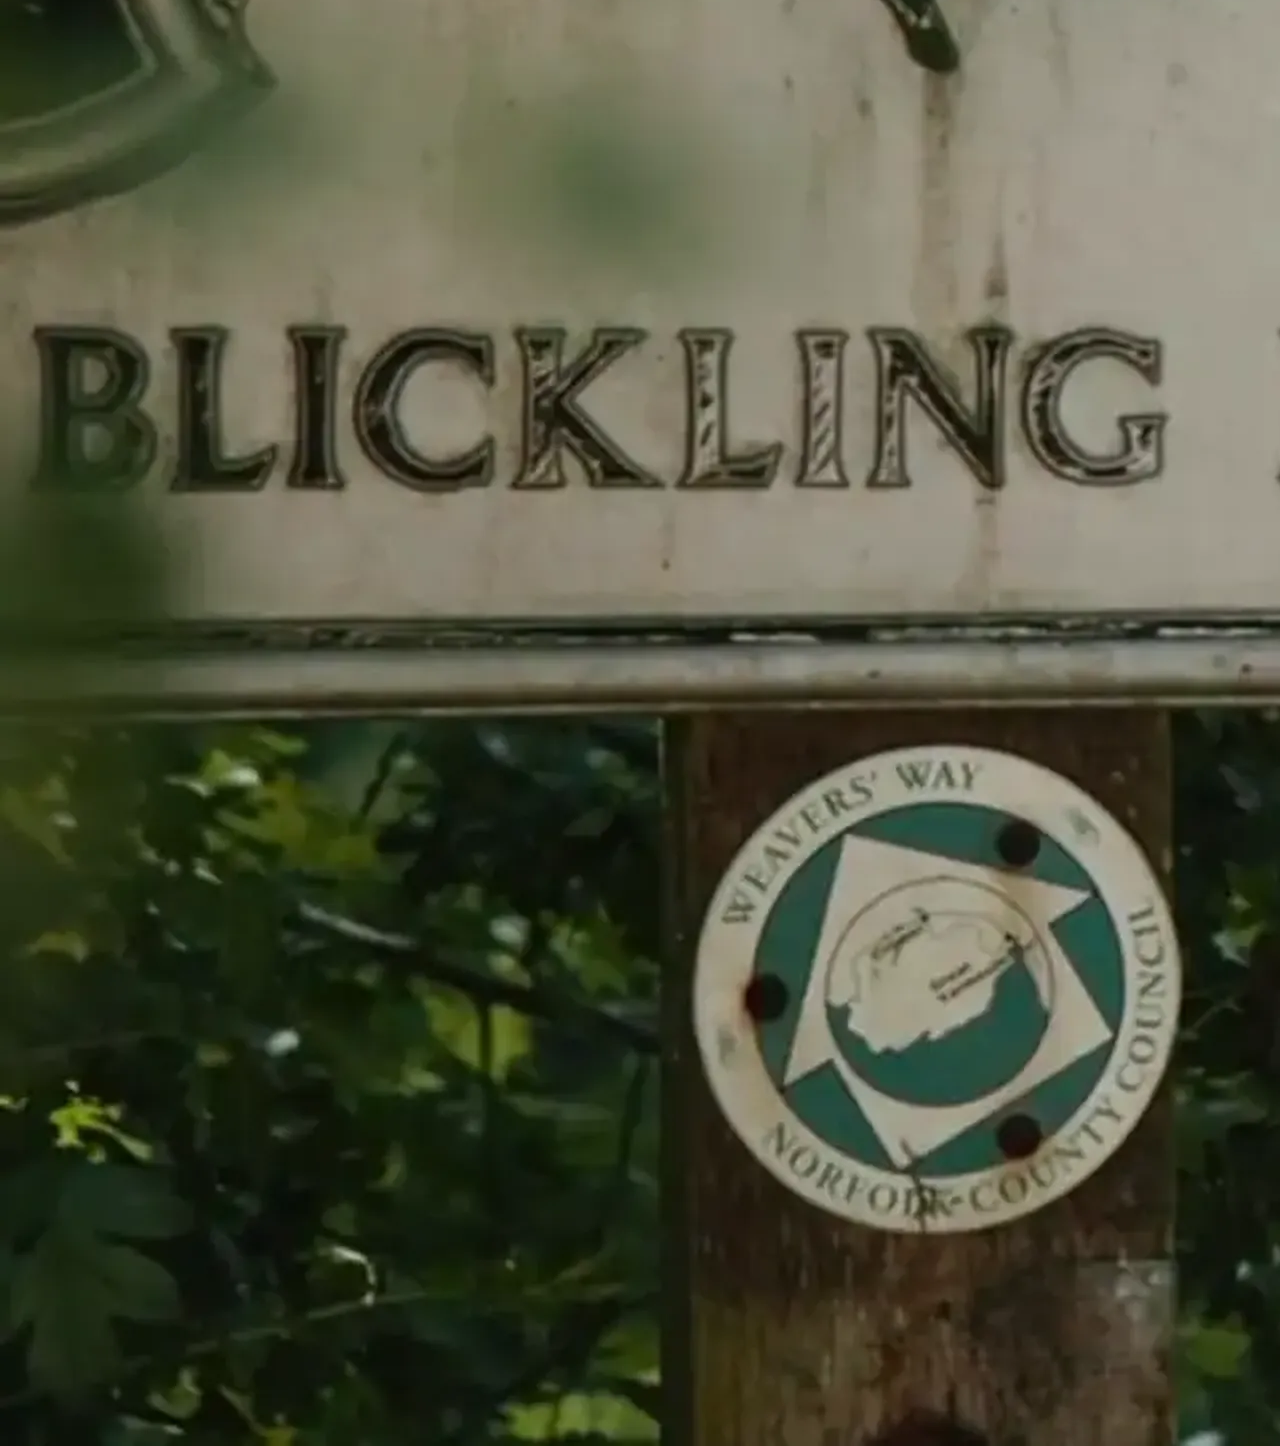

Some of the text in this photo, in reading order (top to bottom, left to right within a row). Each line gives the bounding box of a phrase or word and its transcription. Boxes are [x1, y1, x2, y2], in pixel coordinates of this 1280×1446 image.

[28, 324, 1169, 492] BLICKLING
[720, 761, 983, 925] WEAVERS' WAY
[968, 1095, 1124, 1212] COUNTY
[1115, 895, 1167, 1092] COUNCIL
